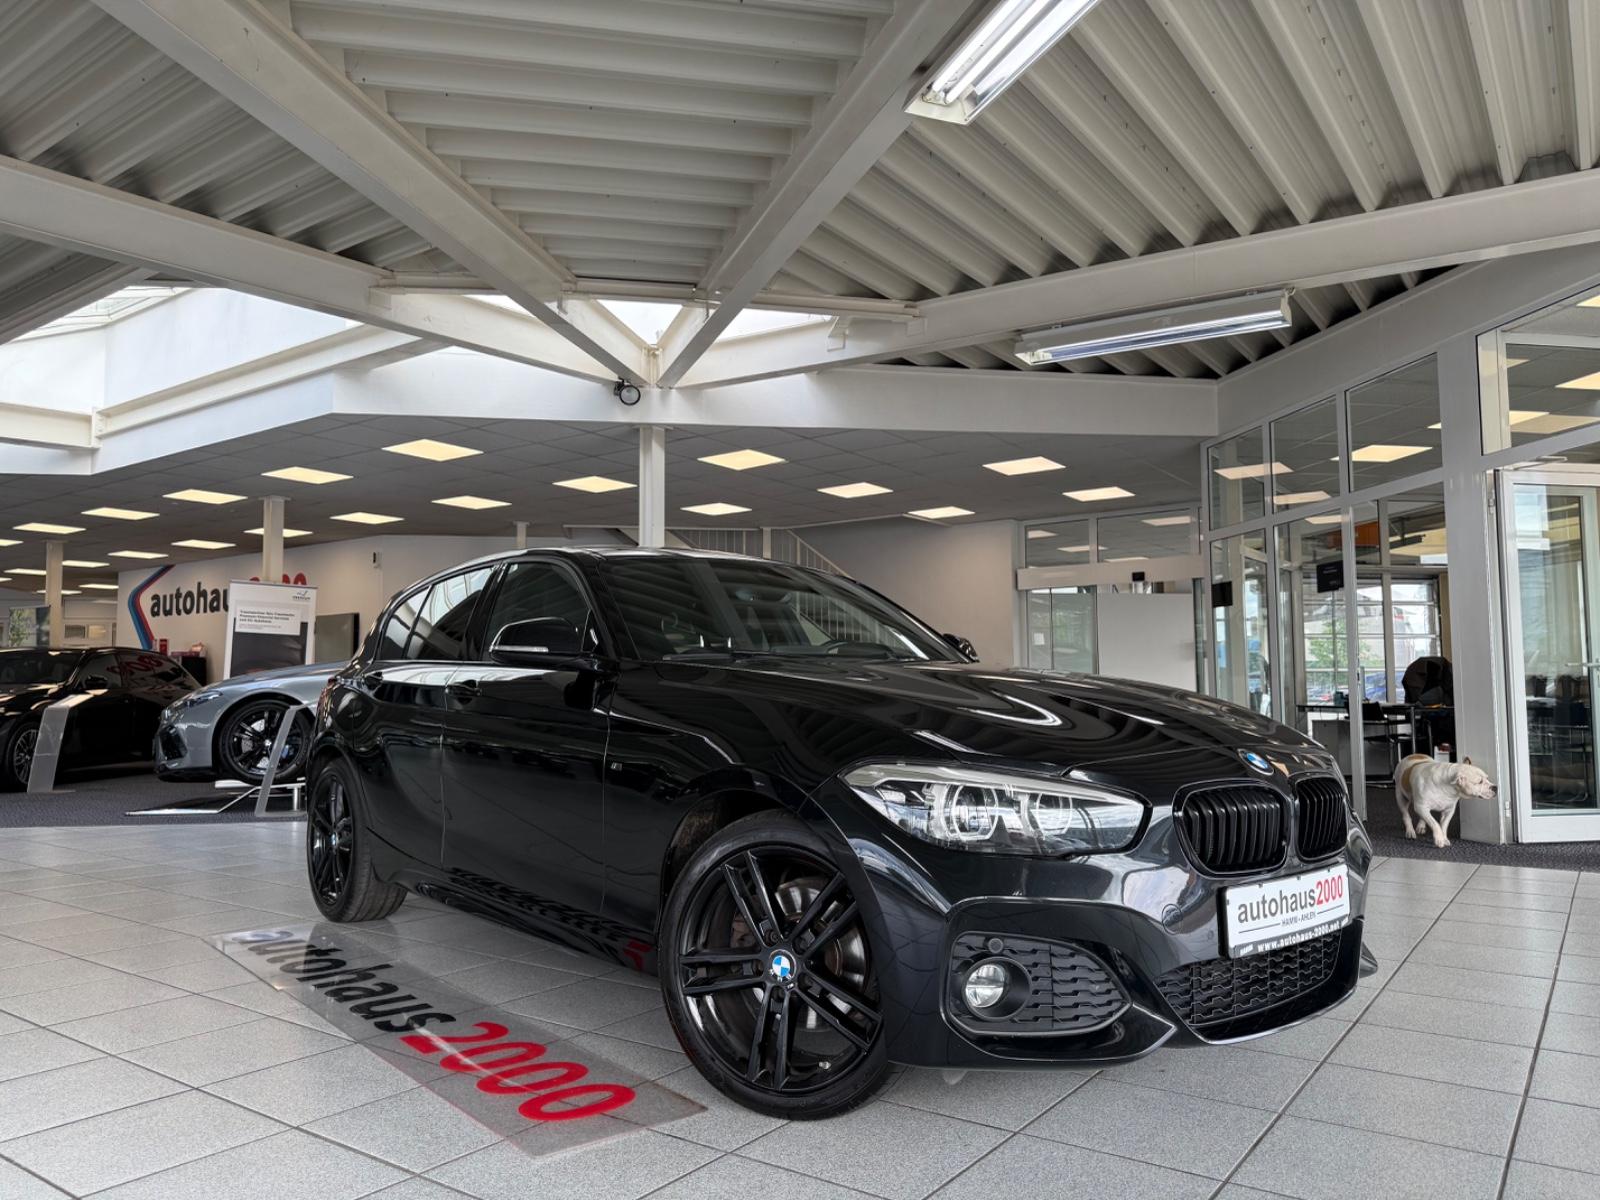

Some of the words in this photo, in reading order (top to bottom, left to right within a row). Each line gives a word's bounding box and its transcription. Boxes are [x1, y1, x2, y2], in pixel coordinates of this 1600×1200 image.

[150, 581, 229, 618] autoha
[1237, 874, 1344, 924] autohaus2000
[231, 930, 636, 1121] autohaus2000
